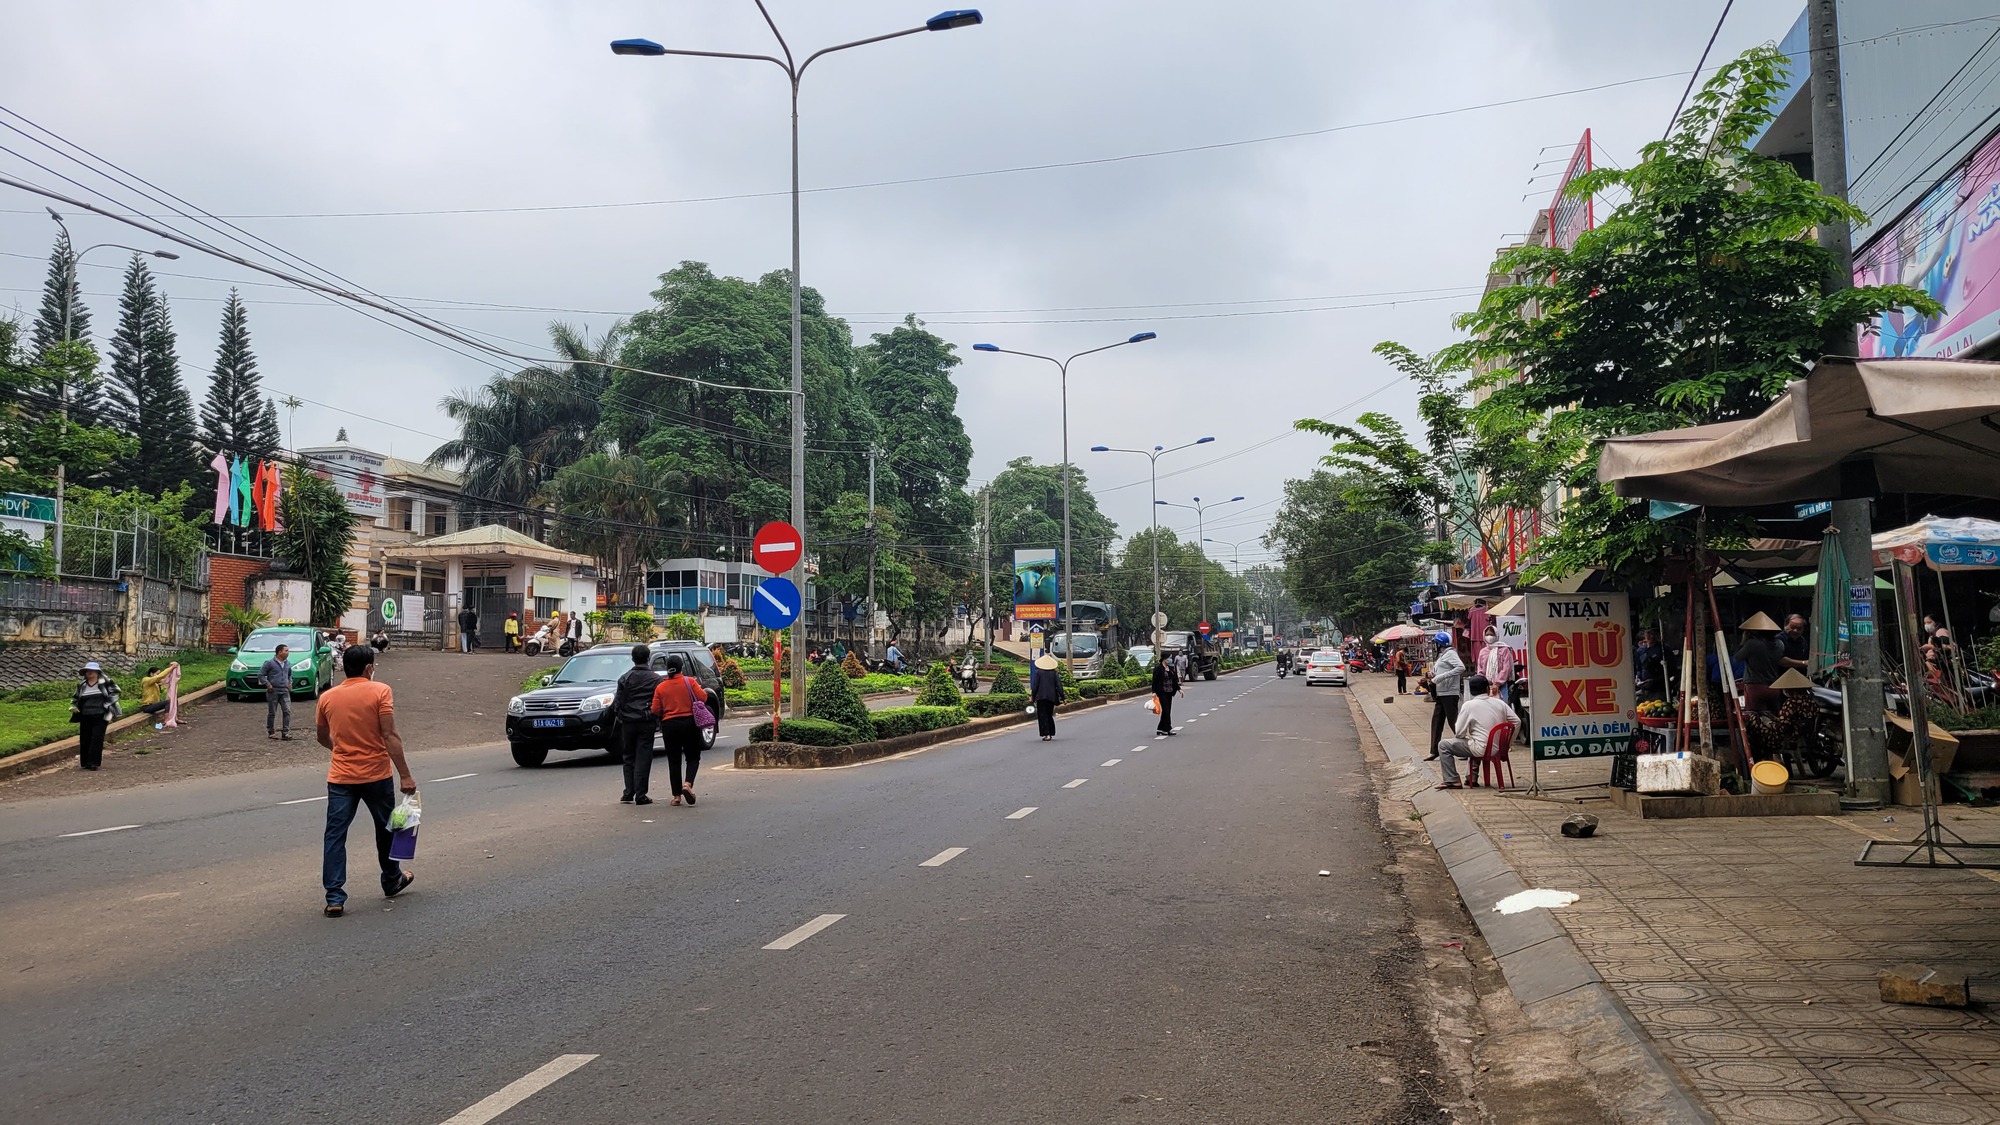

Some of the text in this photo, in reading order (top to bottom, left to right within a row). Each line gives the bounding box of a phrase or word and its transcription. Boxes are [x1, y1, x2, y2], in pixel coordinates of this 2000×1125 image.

[1548, 598, 1610, 621] NHẬN
[1503, 621, 1522, 636] Kim
[1536, 621, 1625, 669] GIỮ
[1551, 678, 1619, 716] XE
[1541, 721, 1630, 737] NGÀY VÀ ĐÊM
[1543, 738, 1629, 757] BẢO ĐẢM
